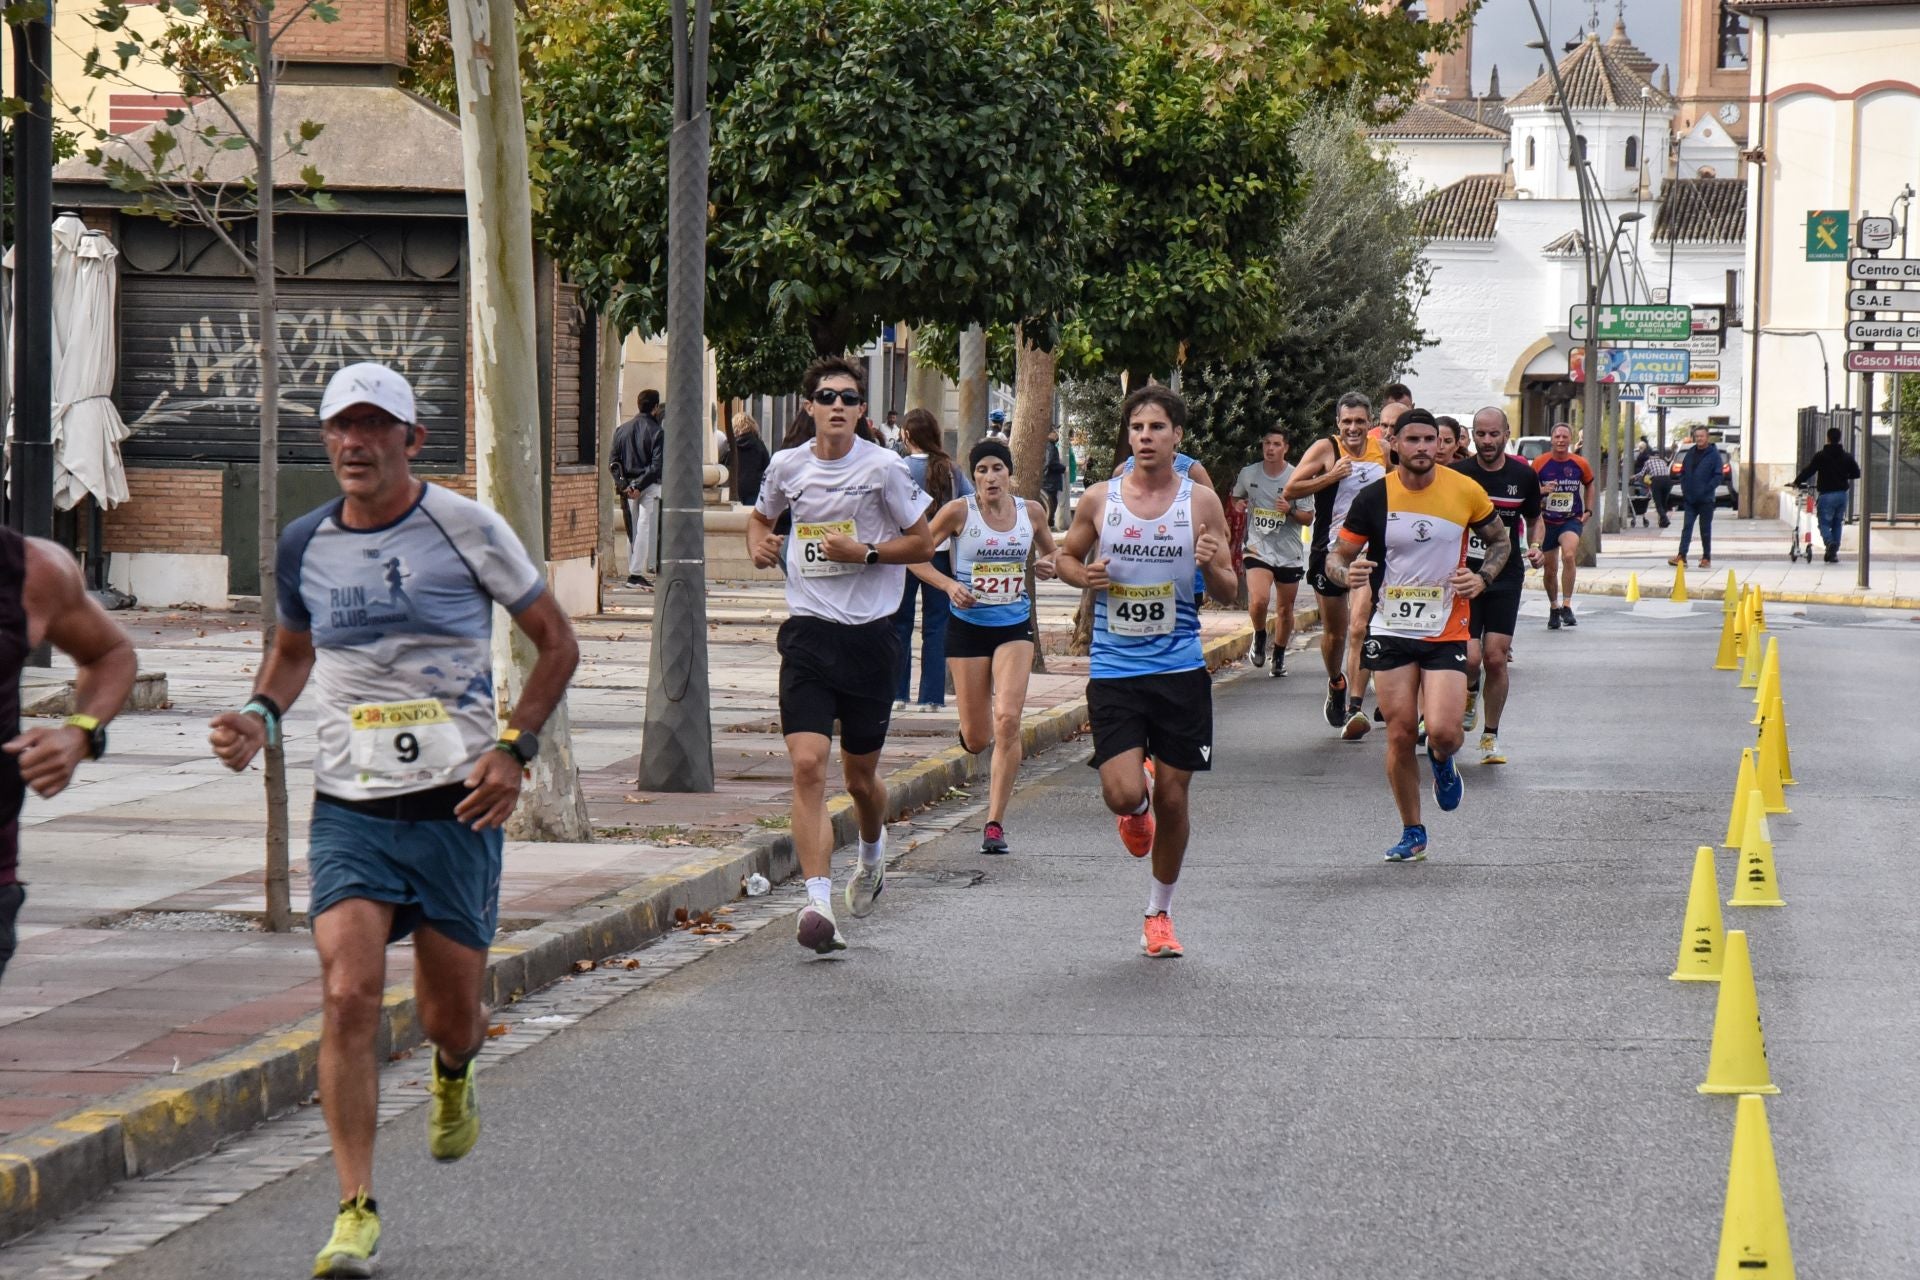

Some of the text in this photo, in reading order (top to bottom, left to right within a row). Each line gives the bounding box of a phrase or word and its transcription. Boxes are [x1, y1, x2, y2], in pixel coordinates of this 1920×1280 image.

[1857, 264, 1899, 276] Centro
[1856, 294, 1892, 306] S.A.E
[1620, 307, 1688, 321] farmacia
[1855, 326, 1903, 337] Guardia
[1632, 361, 1684, 372] AQUÍ
[1854, 354, 1890, 366] Casco
[1639, 373, 1654, 382] 619
[1550, 499, 1569, 507] 858
[976, 548, 1027, 557] MARACENA
[1112, 543, 1183, 557] MARACENA
[973, 577, 1023, 593] 2217
[330, 585, 366, 608] RUN
[1116, 601, 1165, 622] 498
[1399, 602, 1426, 618] 97
[331, 609, 368, 628] CLUB
[363, 707, 438, 724] 38 FONDO
[393, 732, 419, 763] 9
